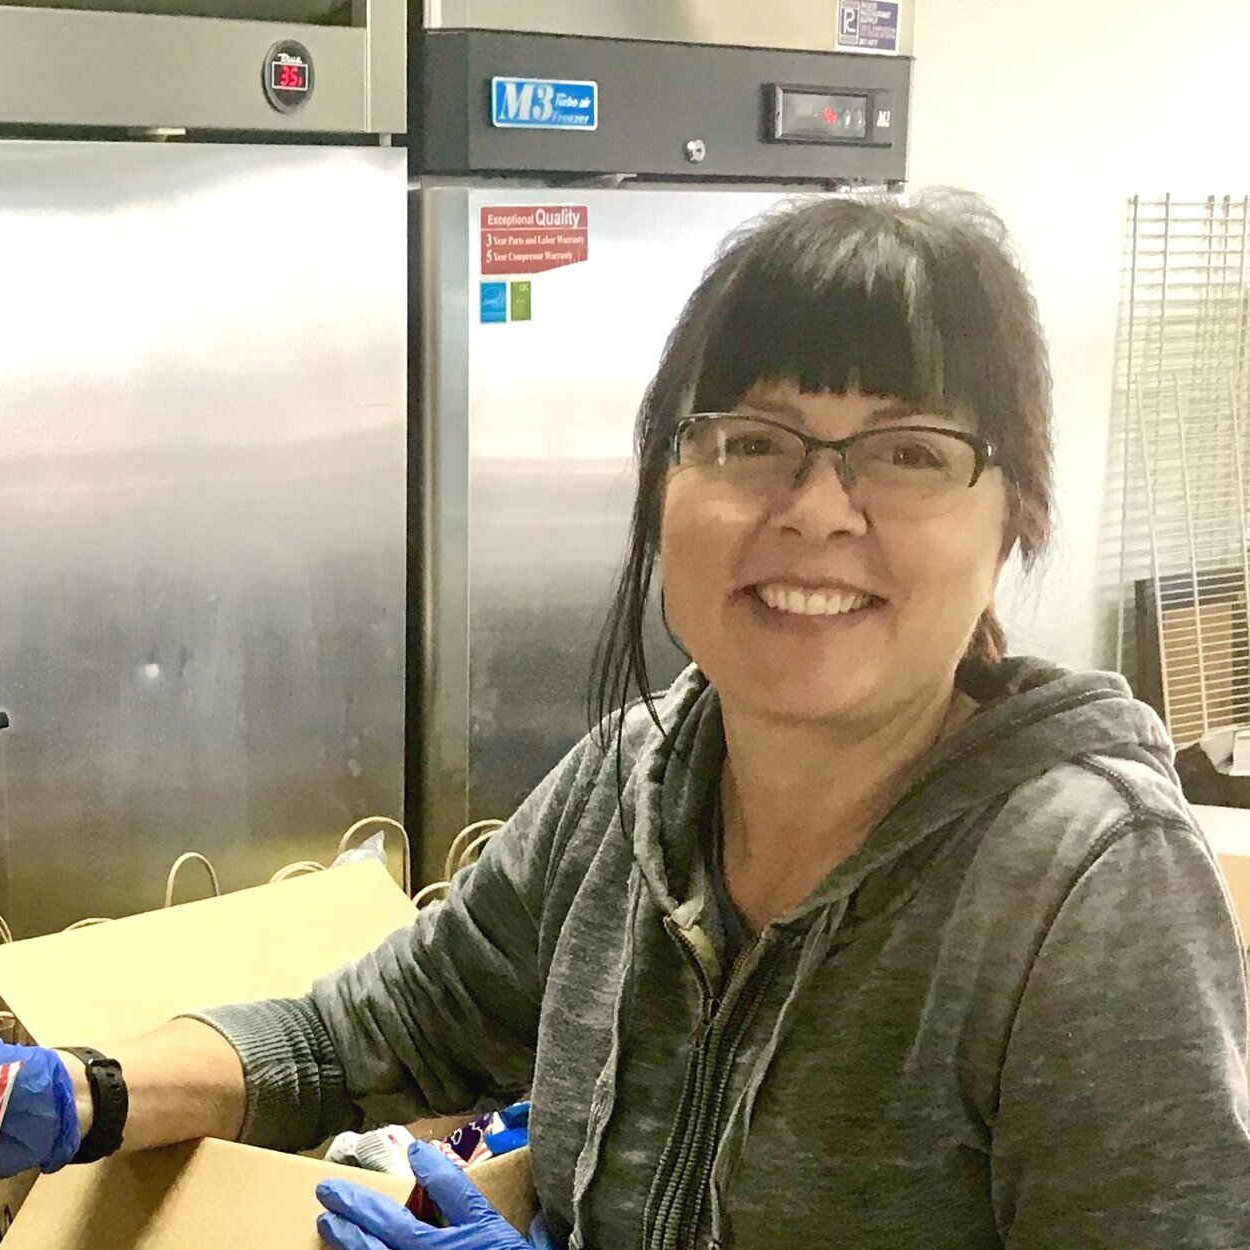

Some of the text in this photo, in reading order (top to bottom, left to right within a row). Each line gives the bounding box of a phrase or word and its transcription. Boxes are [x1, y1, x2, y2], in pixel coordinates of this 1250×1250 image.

[498, 83, 554, 121] M3
[552, 111, 589, 124] Freezer
[487, 208, 581, 229] Exceptional Quality
[486, 233, 493, 248] 3
[525, 235, 537, 245] and
[557, 235, 585, 246] Warranty
[486, 249, 493, 263] 5
[545, 251, 573, 261] Warranty
